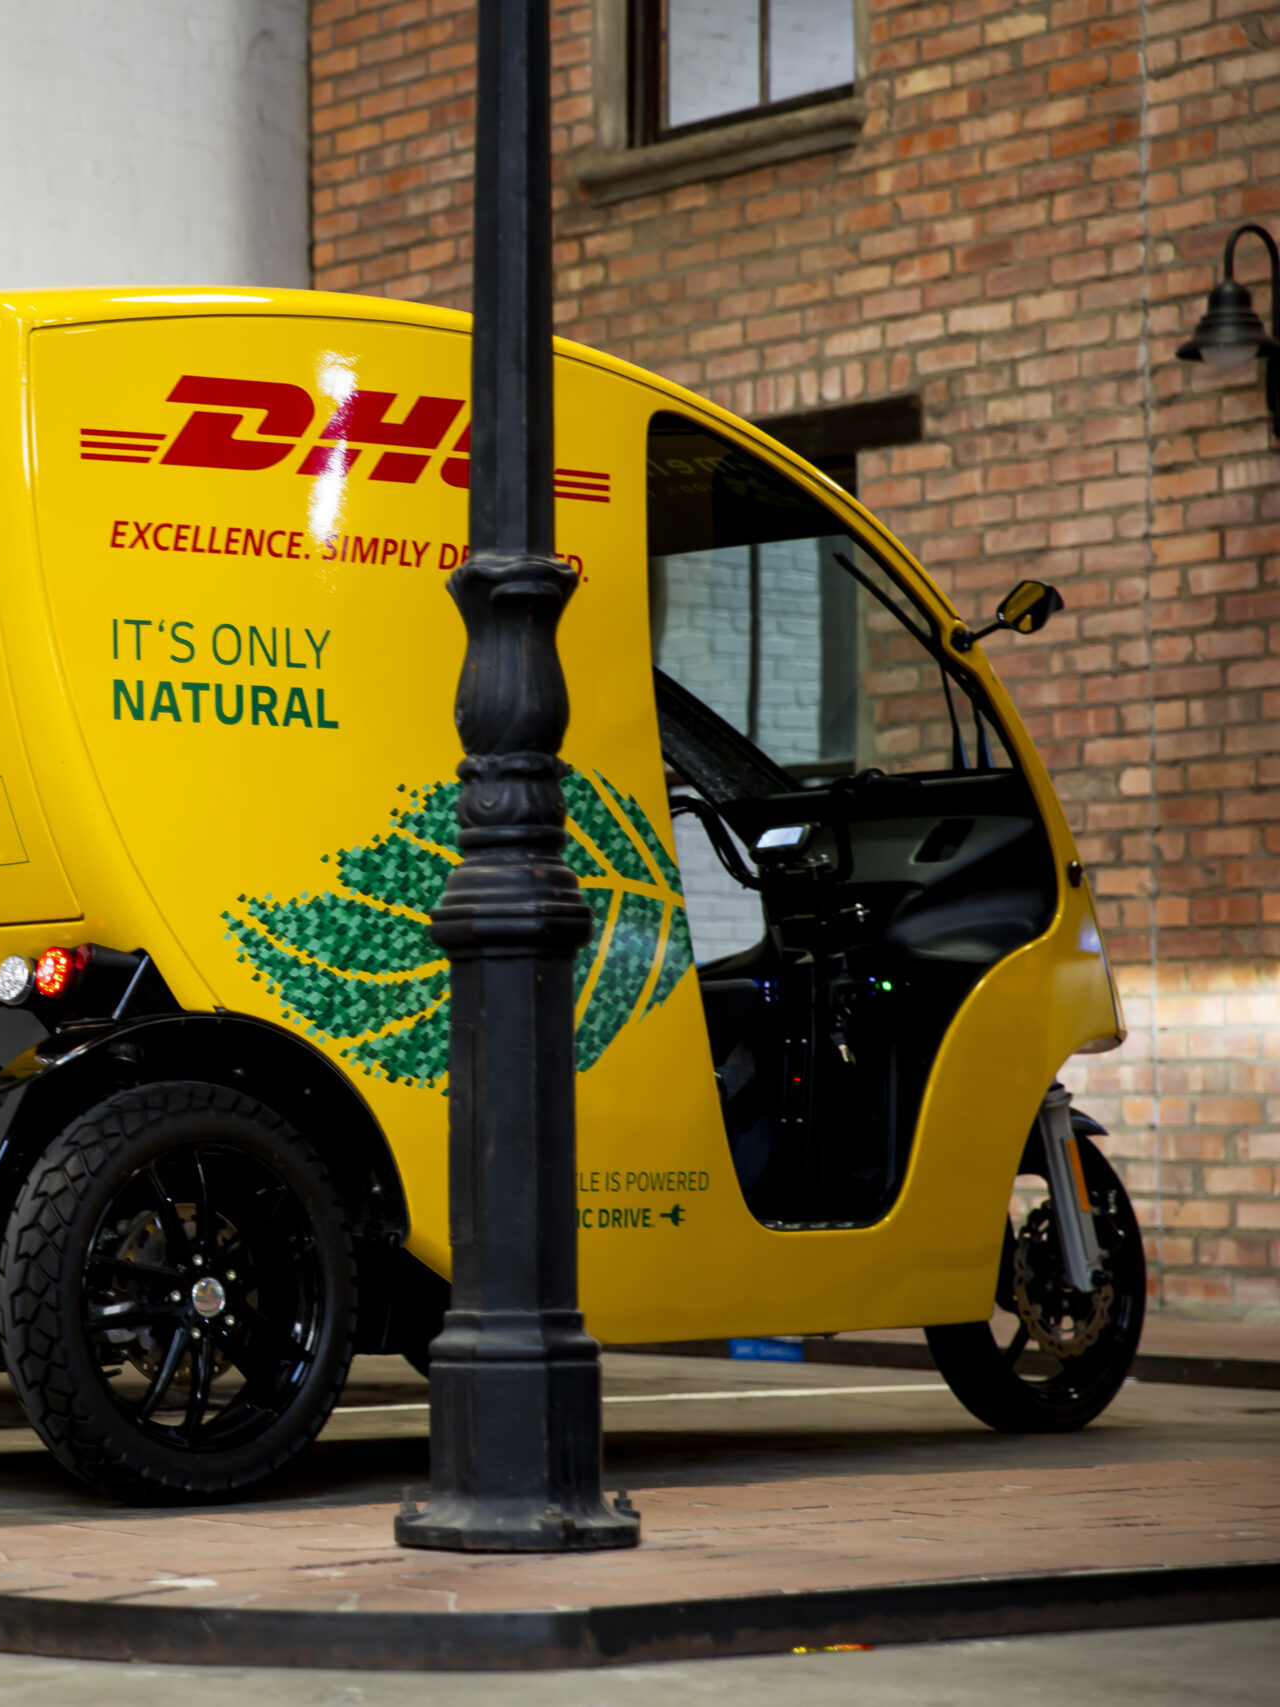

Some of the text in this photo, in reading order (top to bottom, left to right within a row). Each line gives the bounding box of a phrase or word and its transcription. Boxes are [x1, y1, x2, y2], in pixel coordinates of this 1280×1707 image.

[159, 374, 471, 489] DH
[110, 519, 310, 560] EXCELLENCE.
[322, 533, 431, 568] SIMPLY
[112, 618, 331, 670] IT'S ONLY
[113, 678, 339, 730] NATURAL
[605, 1171, 621, 1192] IS
[626, 1171, 710, 1192] POWERED
[598, 1208, 656, 1229] DRIVE.
